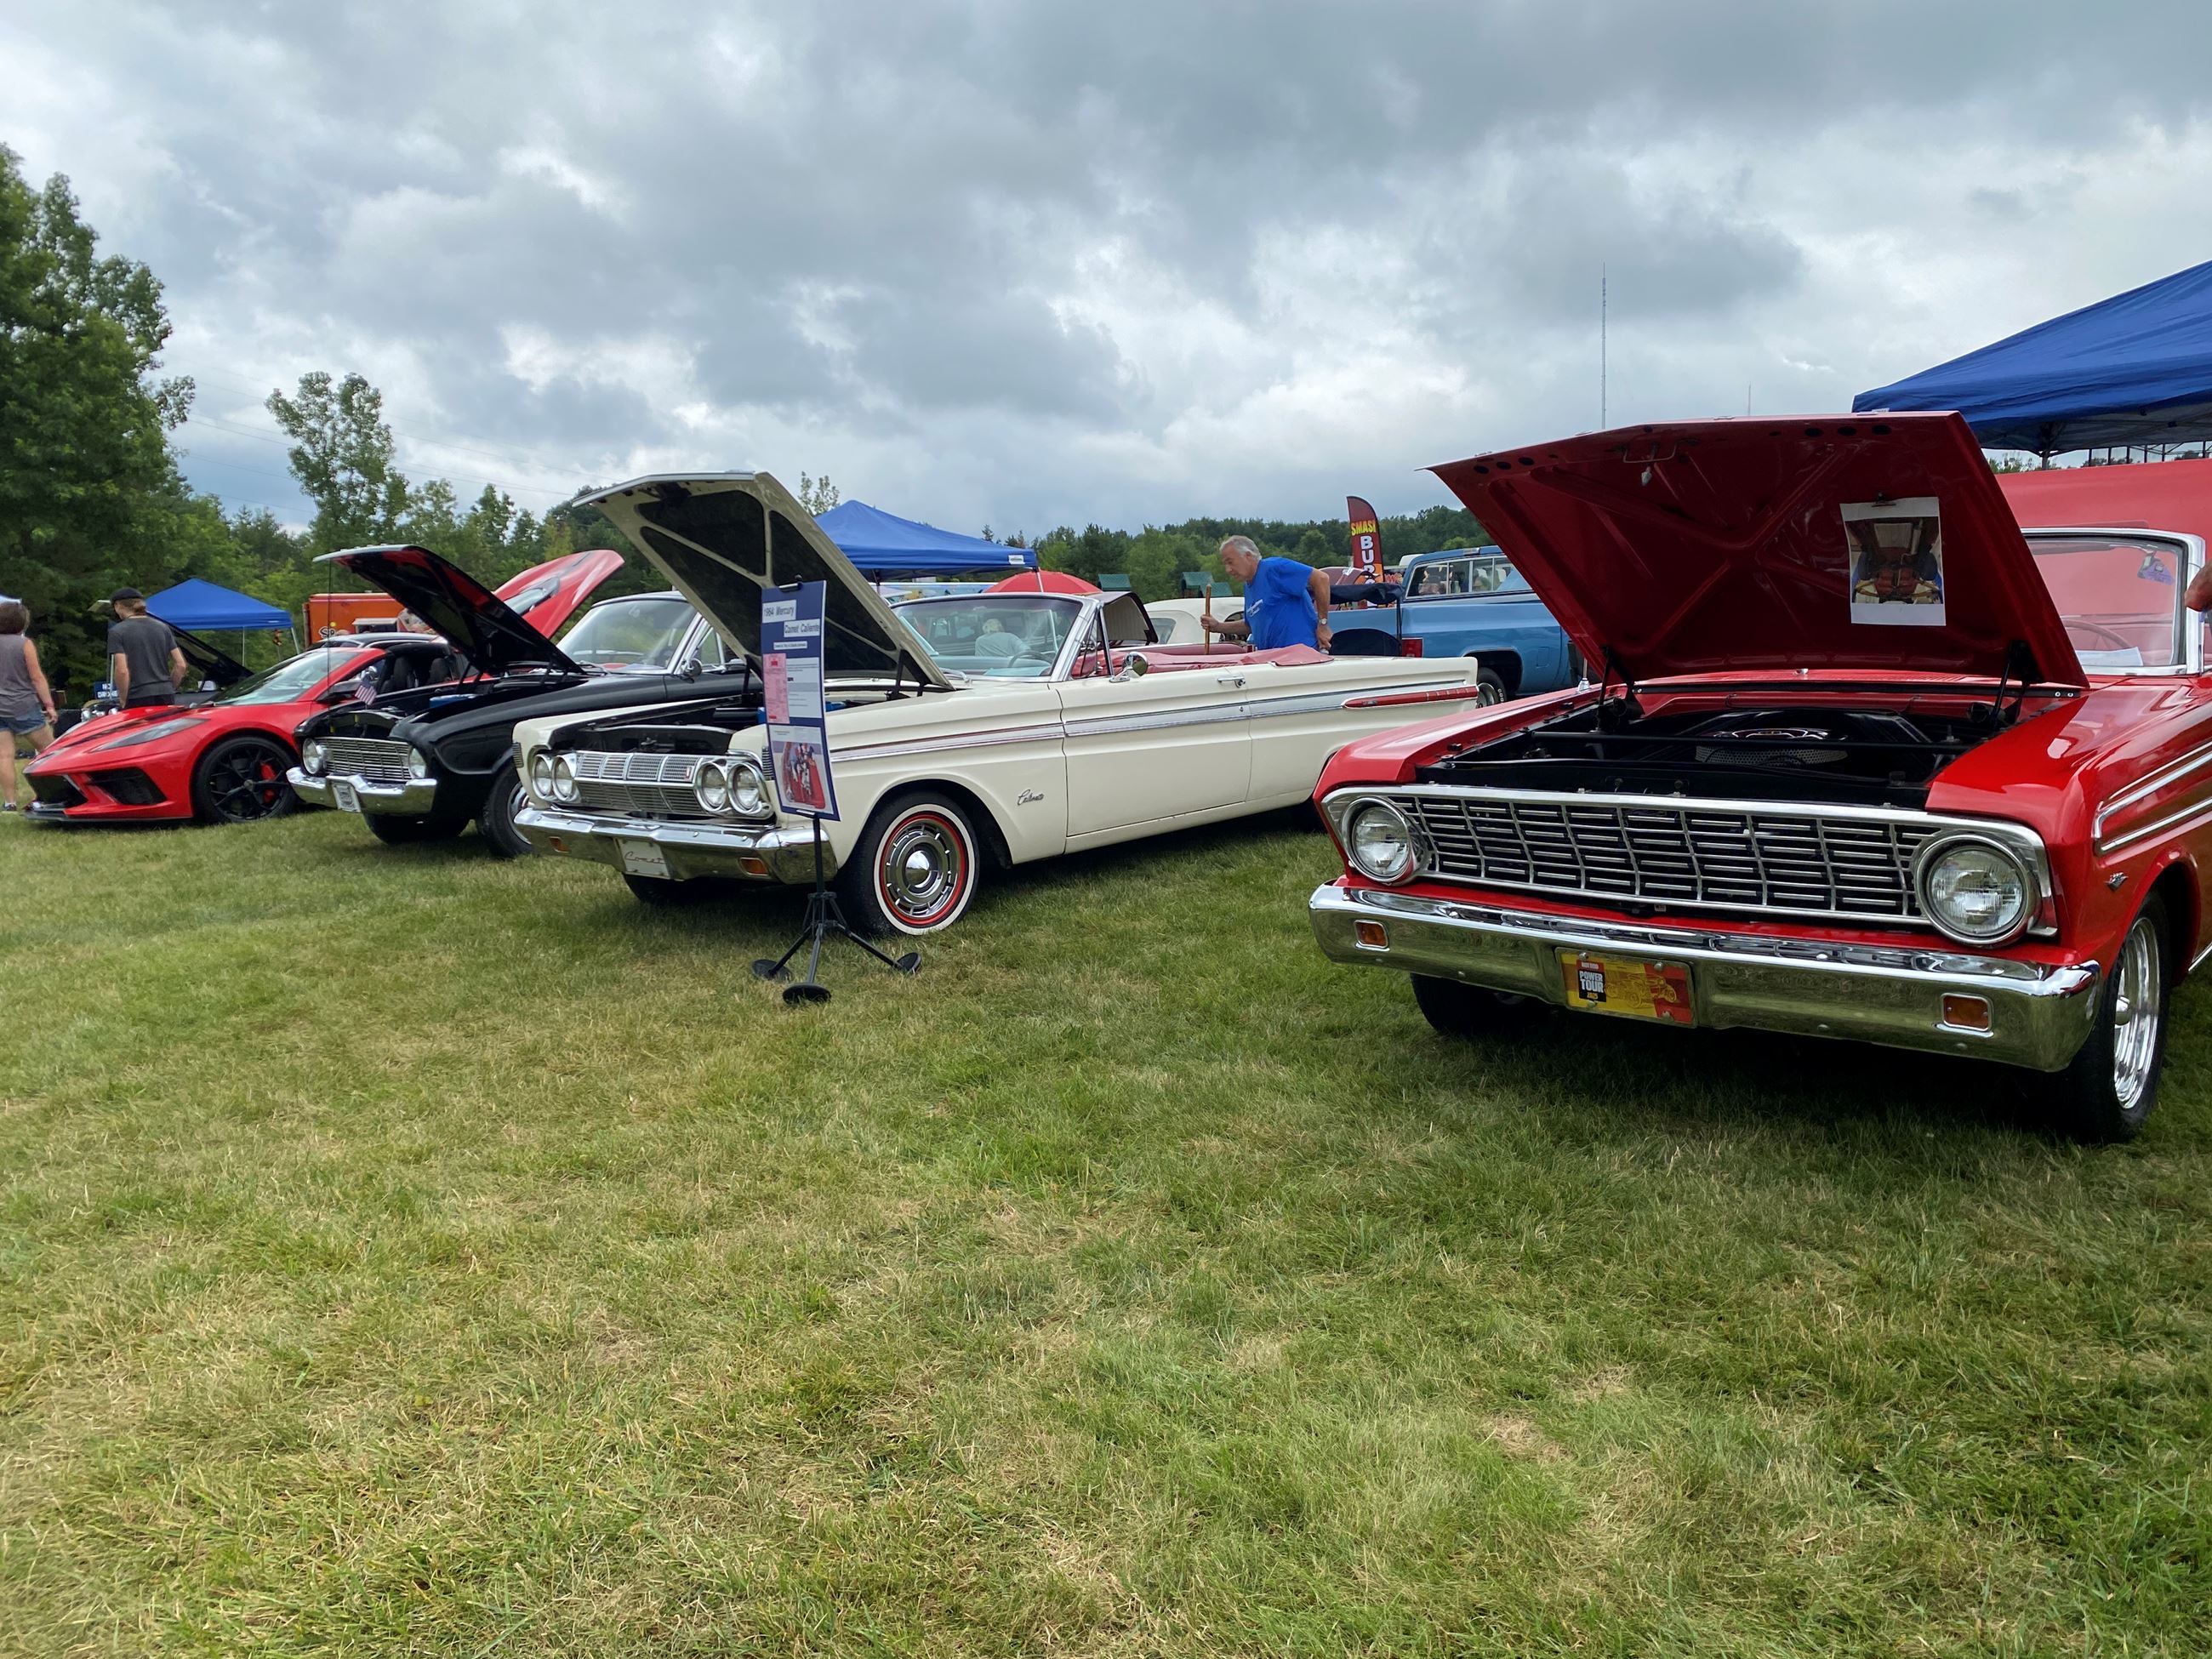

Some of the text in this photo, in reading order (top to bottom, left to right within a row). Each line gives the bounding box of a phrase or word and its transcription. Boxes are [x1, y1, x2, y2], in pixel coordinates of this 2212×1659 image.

[776, 606, 795, 617] Mercury
[624, 851, 665, 864] Comet
[1579, 971, 1603, 982] POWER
[1580, 978, 1604, 993] TOUR
